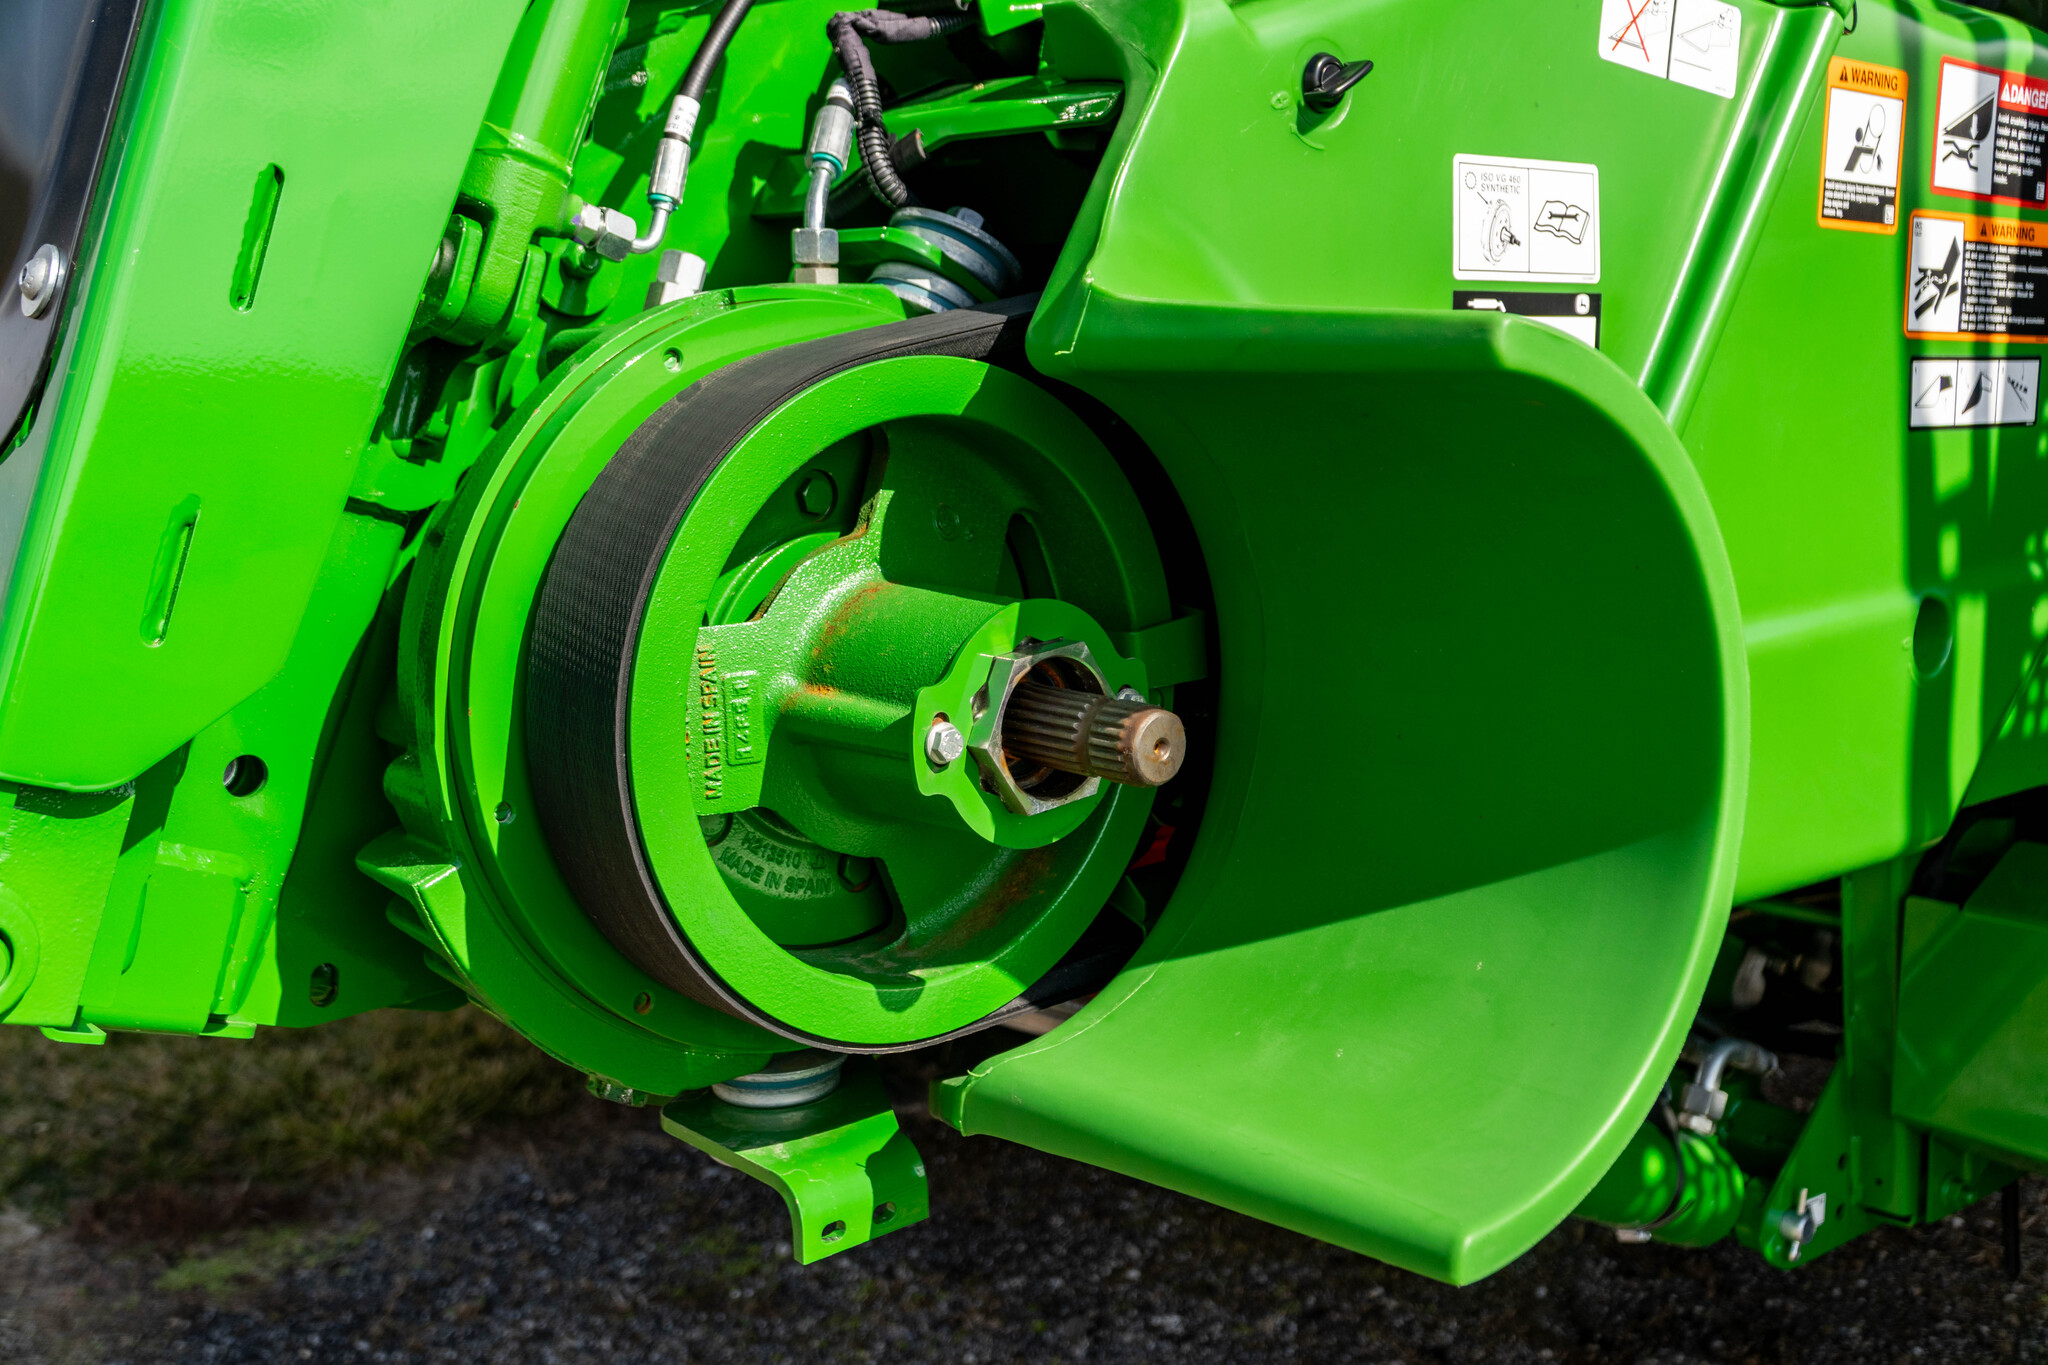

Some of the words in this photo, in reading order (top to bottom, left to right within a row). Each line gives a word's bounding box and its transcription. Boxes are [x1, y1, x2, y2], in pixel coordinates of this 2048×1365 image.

[1851, 67, 1899, 91] WARNING
[1481, 173, 1494, 182] ISO
[1496, 174, 1507, 183] VG
[1481, 183, 1521, 194] SYNTHETIC
[1991, 224, 2035, 241] WARNING
[697, 643, 718, 709] SPAIN
[702, 713, 719, 735] IN
[705, 735, 723, 800] MADE
[717, 846, 765, 884] MADE
[764, 871, 783, 890] IN
[784, 876, 832, 894] SPAIN
